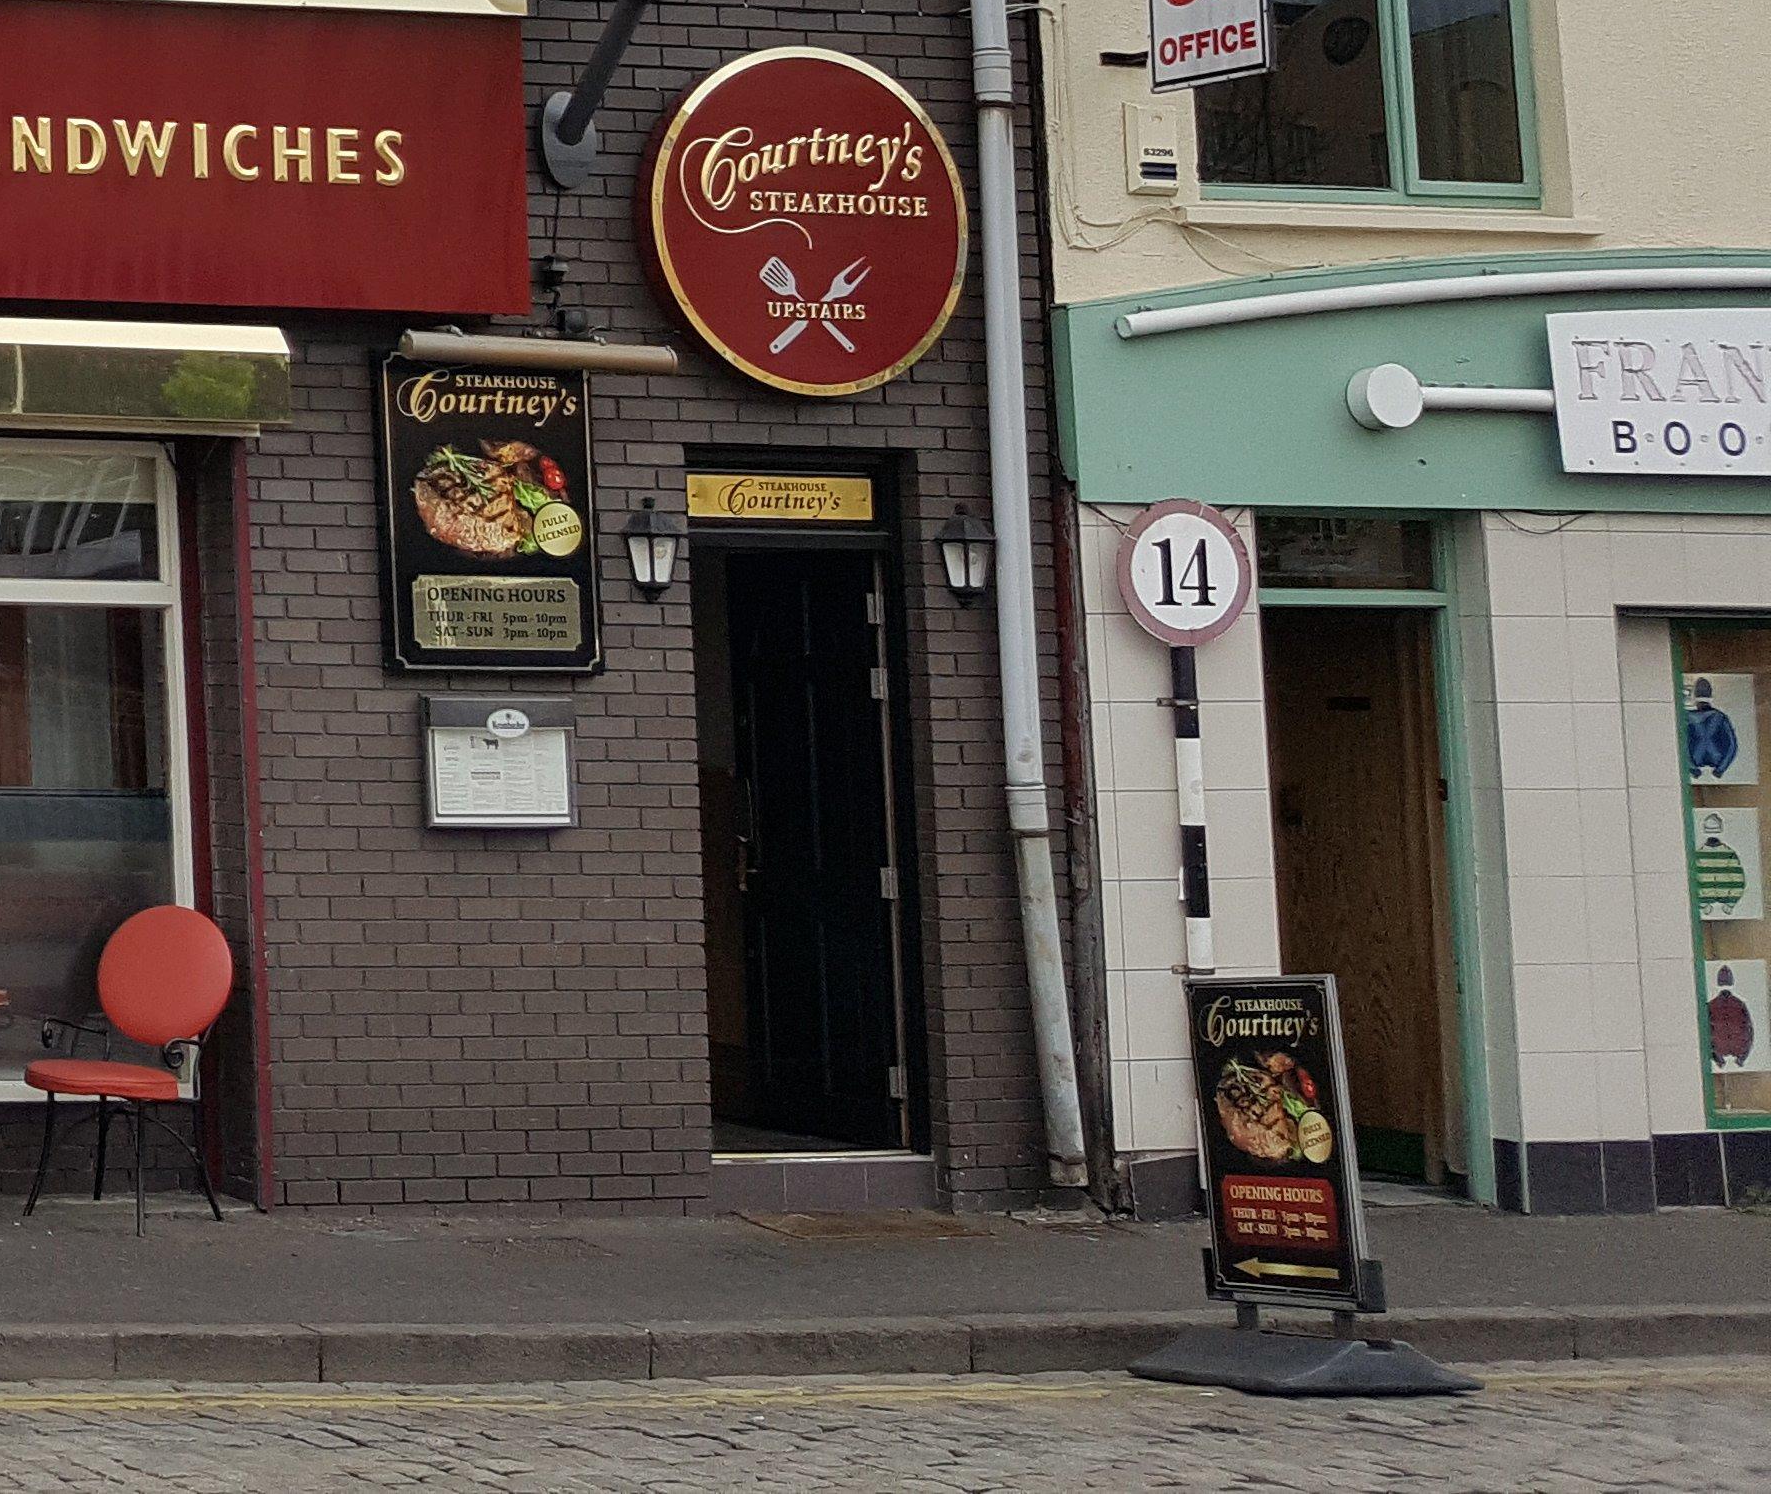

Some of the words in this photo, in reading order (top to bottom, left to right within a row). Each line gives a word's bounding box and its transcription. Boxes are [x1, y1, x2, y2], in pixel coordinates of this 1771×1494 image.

[1160, 20, 1257, 66] OFFICE
[680, 122, 923, 233] Courtney's
[750, 191, 928, 217] STEAKHOUSE
[768, 301, 867, 321] UPSTAIRS
[455, 374, 557, 390] STEAKHOUSE
[1572, 340, 1771, 404] FRAN
[397, 370, 579, 427] Courtney's
[758, 481, 827, 492] STEAKHOUSE
[718, 479, 842, 518] Courtney's
[541, 513, 570, 529] FULLY
[537, 524, 581, 543] LICENSED
[1150, 538, 1217, 606] 14
[427, 587, 505, 602] OPENING
[509, 588, 566, 603] HOURS
[1235, 999, 1304, 1012] STEAKHOUSE
[1199, 996, 1319, 1047] Courtney's
[1229, 1185, 1282, 1201] OPENING
[1283, 1187, 1325, 1203] HOURS
